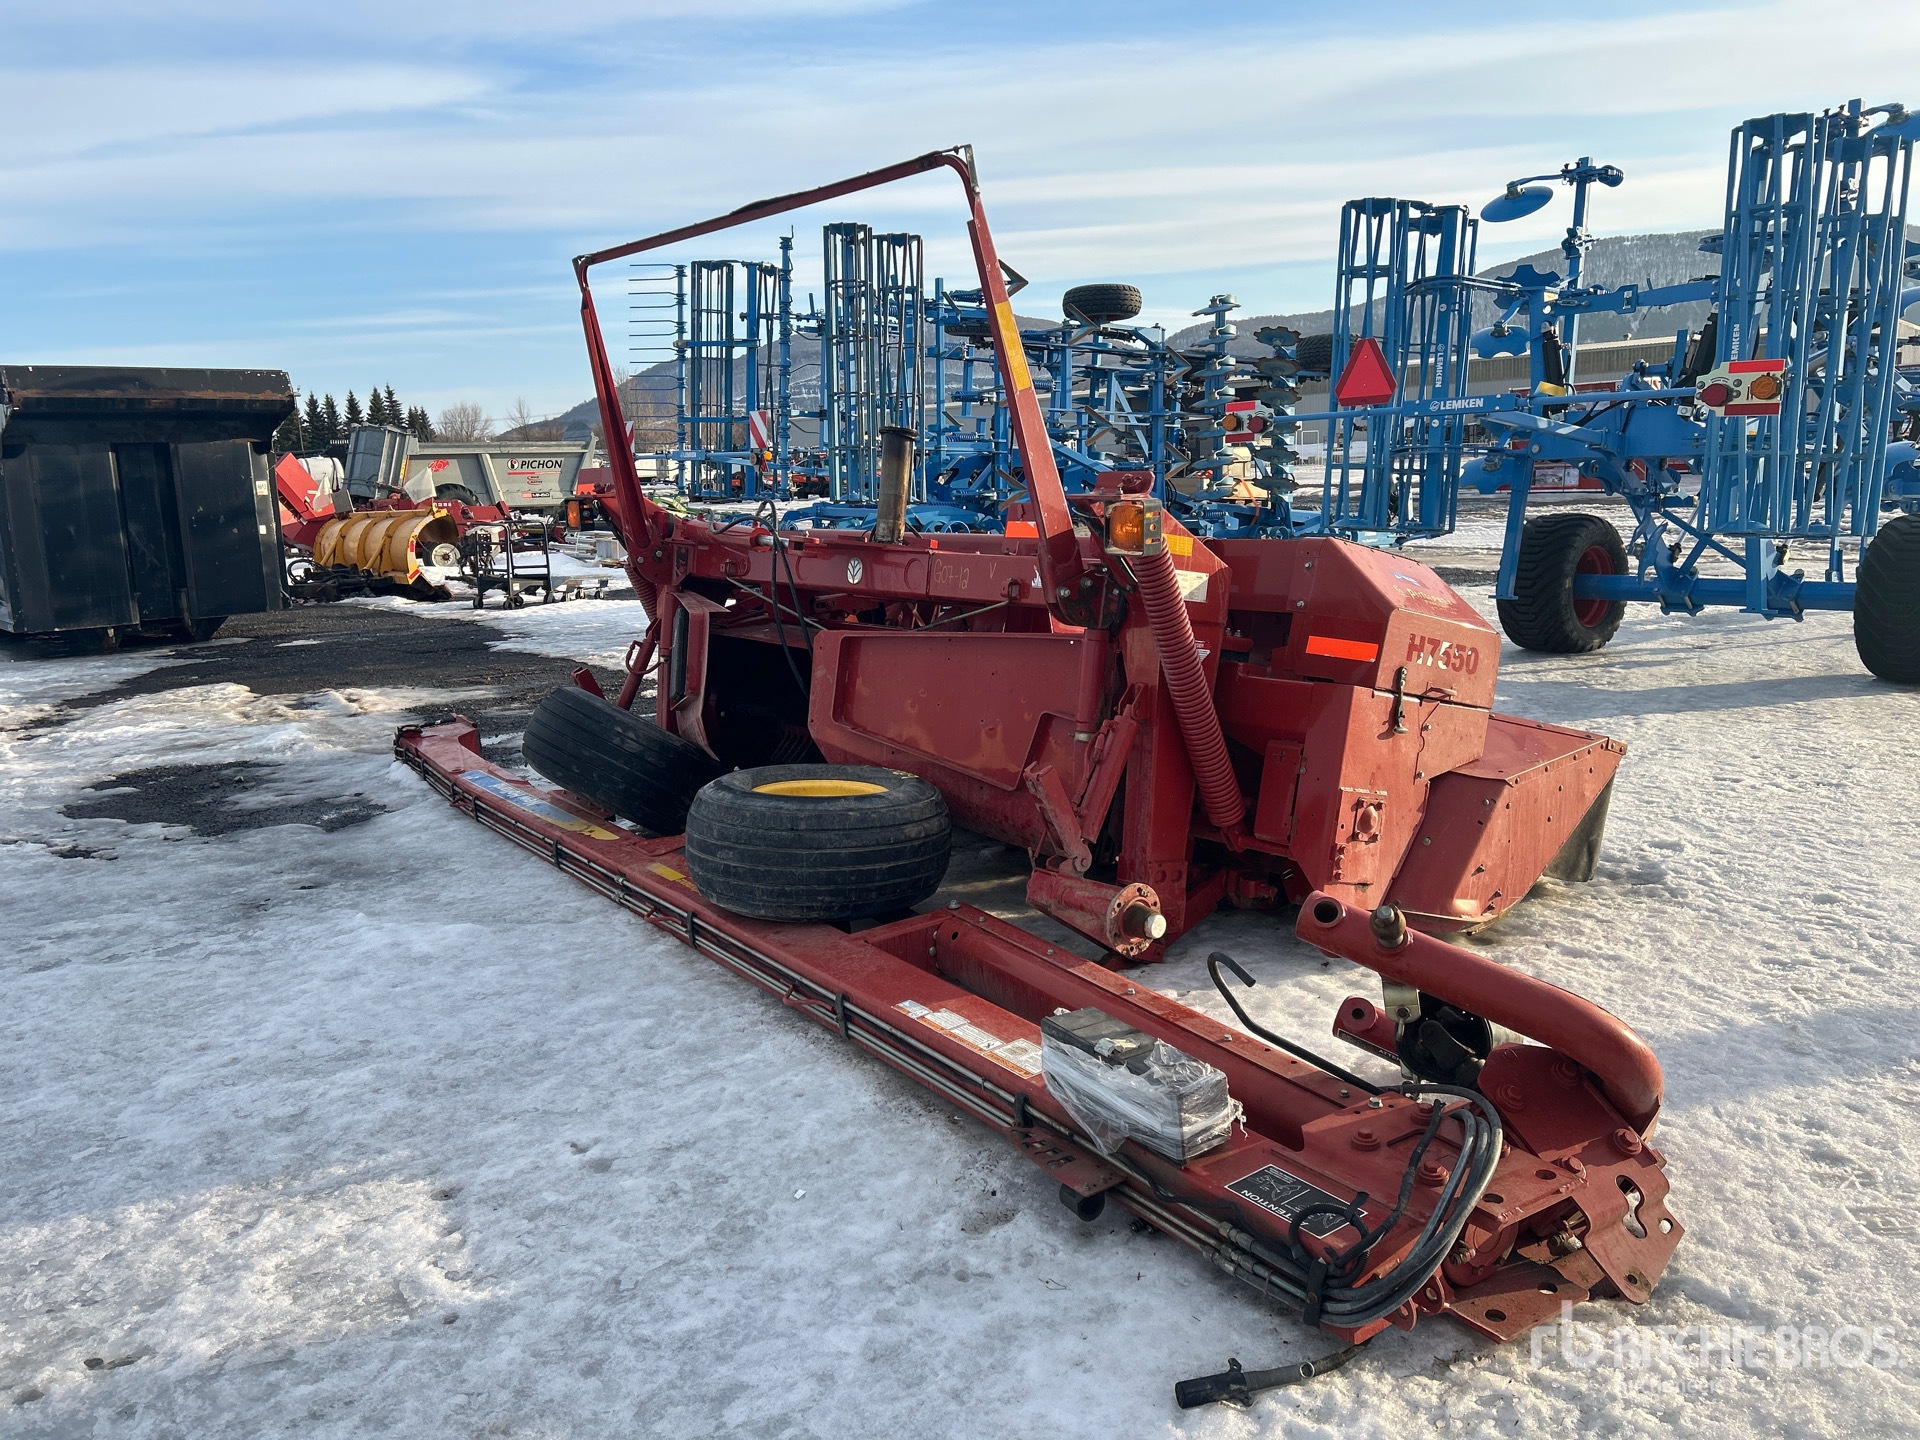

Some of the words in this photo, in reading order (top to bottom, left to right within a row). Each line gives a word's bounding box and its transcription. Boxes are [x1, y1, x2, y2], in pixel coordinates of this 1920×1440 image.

[1731, 324, 1740, 361] EMKEN
[1435, 352, 1444, 387] LEMKEN
[1440, 398, 1484, 410] LEMKEN
[521, 460, 562, 469] PICHON
[1406, 633, 1479, 675] H7550
[1241, 1189, 1309, 1226] ATENTION
